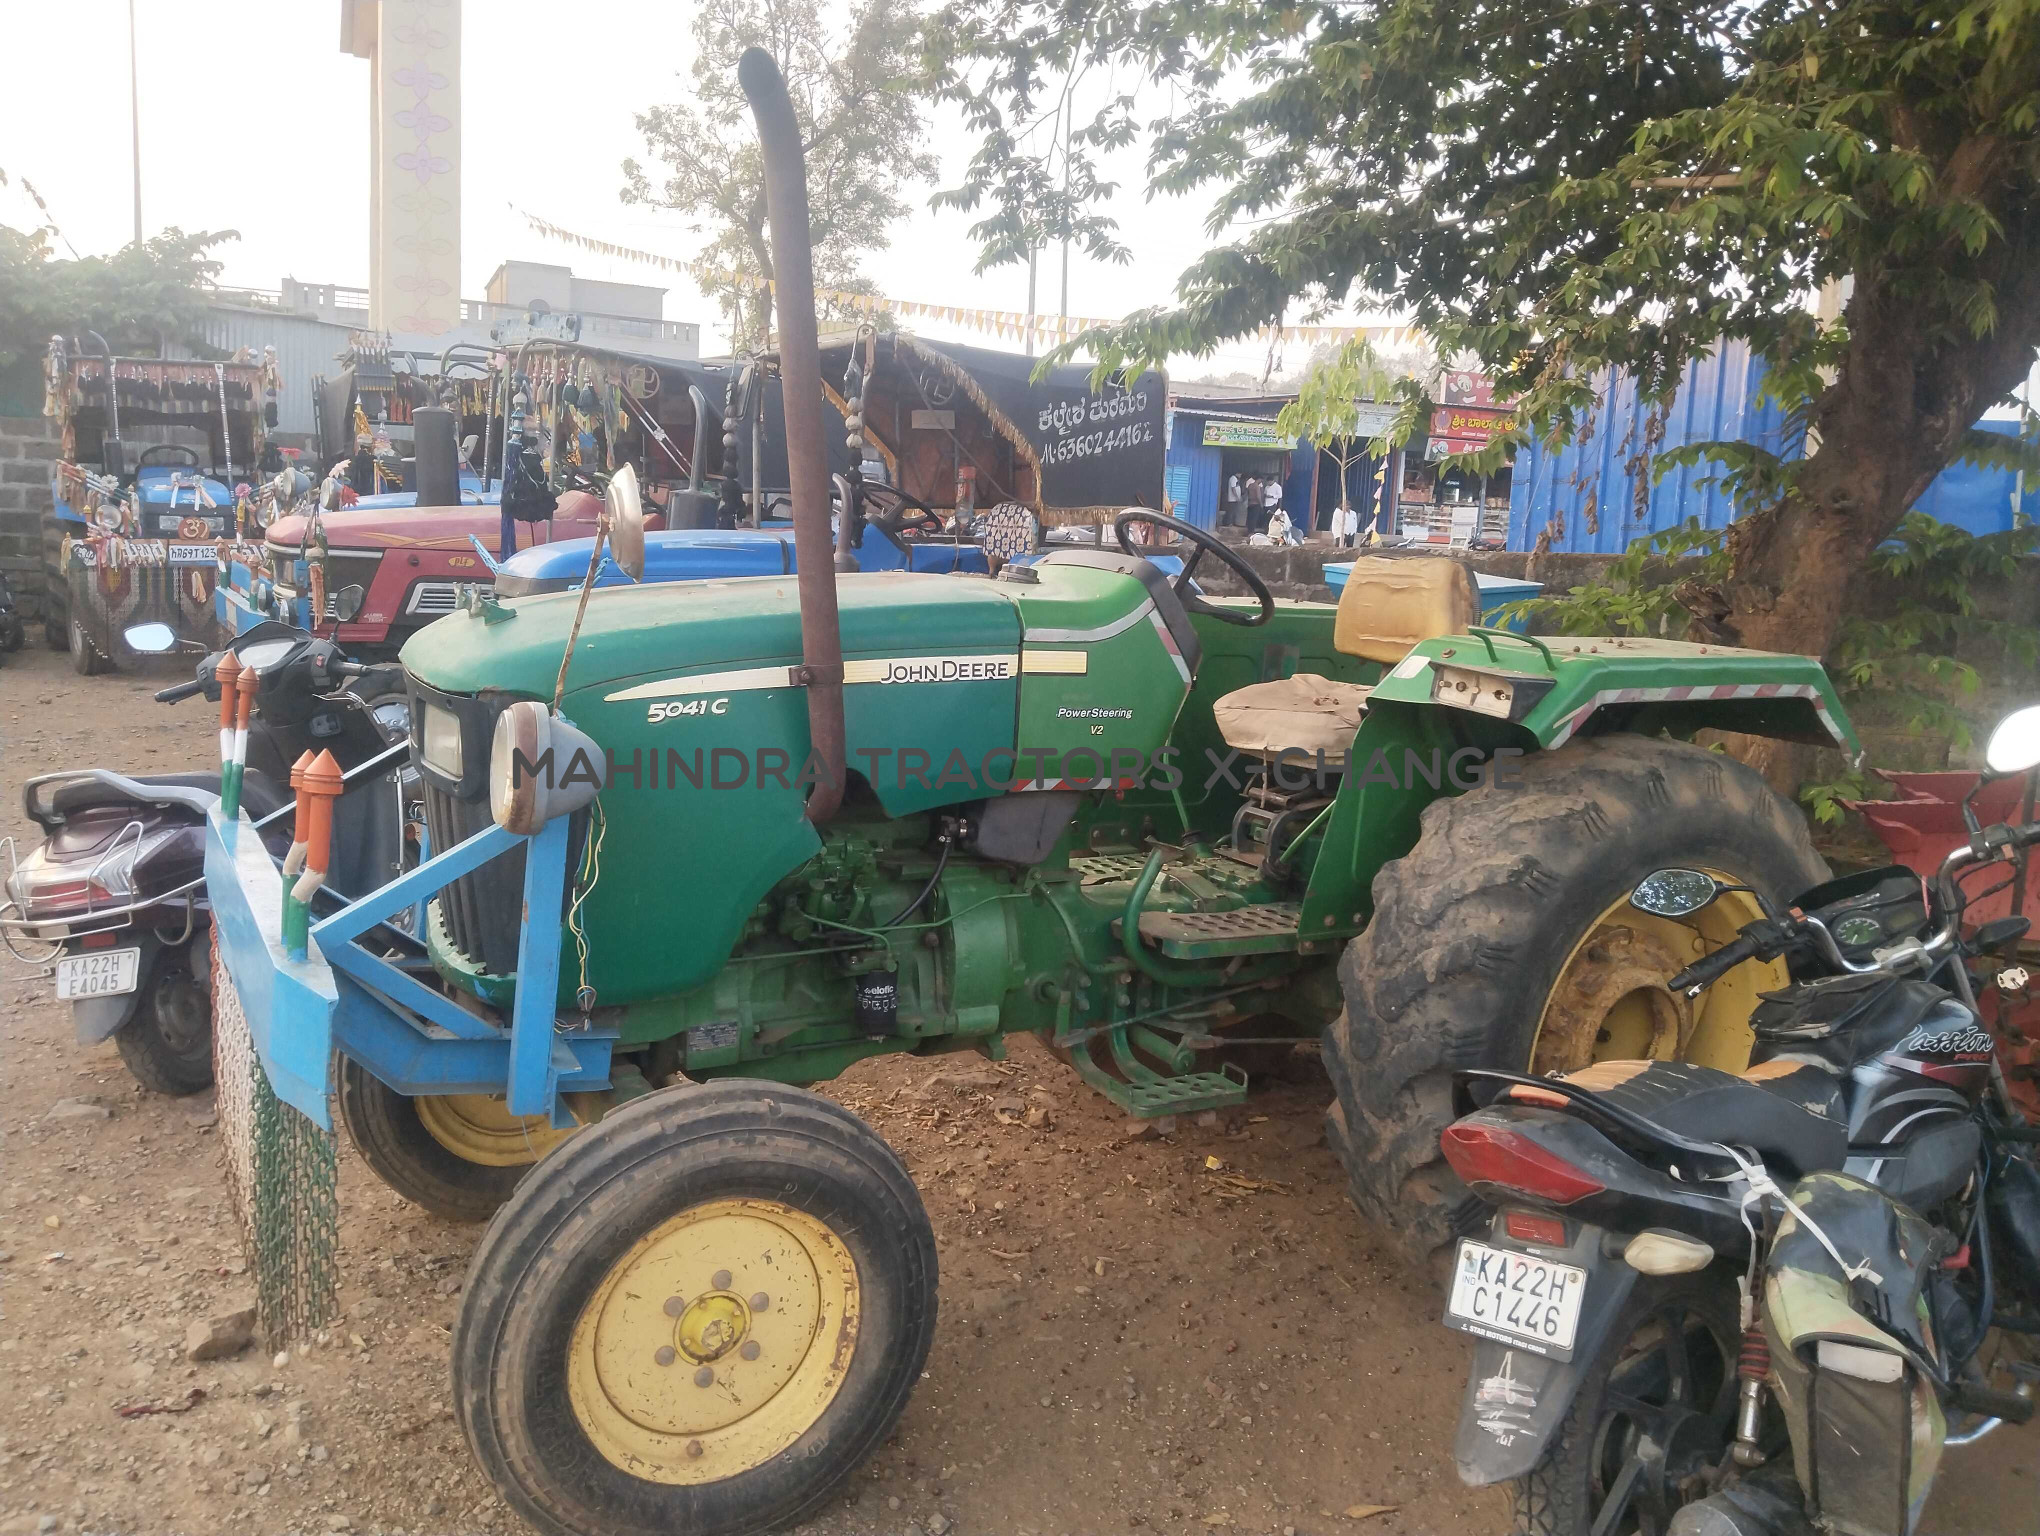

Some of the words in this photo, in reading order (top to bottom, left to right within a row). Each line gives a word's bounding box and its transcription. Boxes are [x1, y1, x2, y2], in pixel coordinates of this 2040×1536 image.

[881, 662, 938, 681] JOHN
[942, 660, 1009, 679] DEERE
[647, 699, 708, 723] 5041
[711, 698, 729, 714] C
[1090, 725, 1104, 735] V2
[70, 956, 120, 977] KA22H
[70, 974, 119, 996] E4045
[1478, 1251, 1567, 1303] KA22H
[1472, 1286, 1560, 1336] C1446
[1469, 1325, 1486, 1336] STAR
[1486, 1330, 1513, 1344] MOTORS
